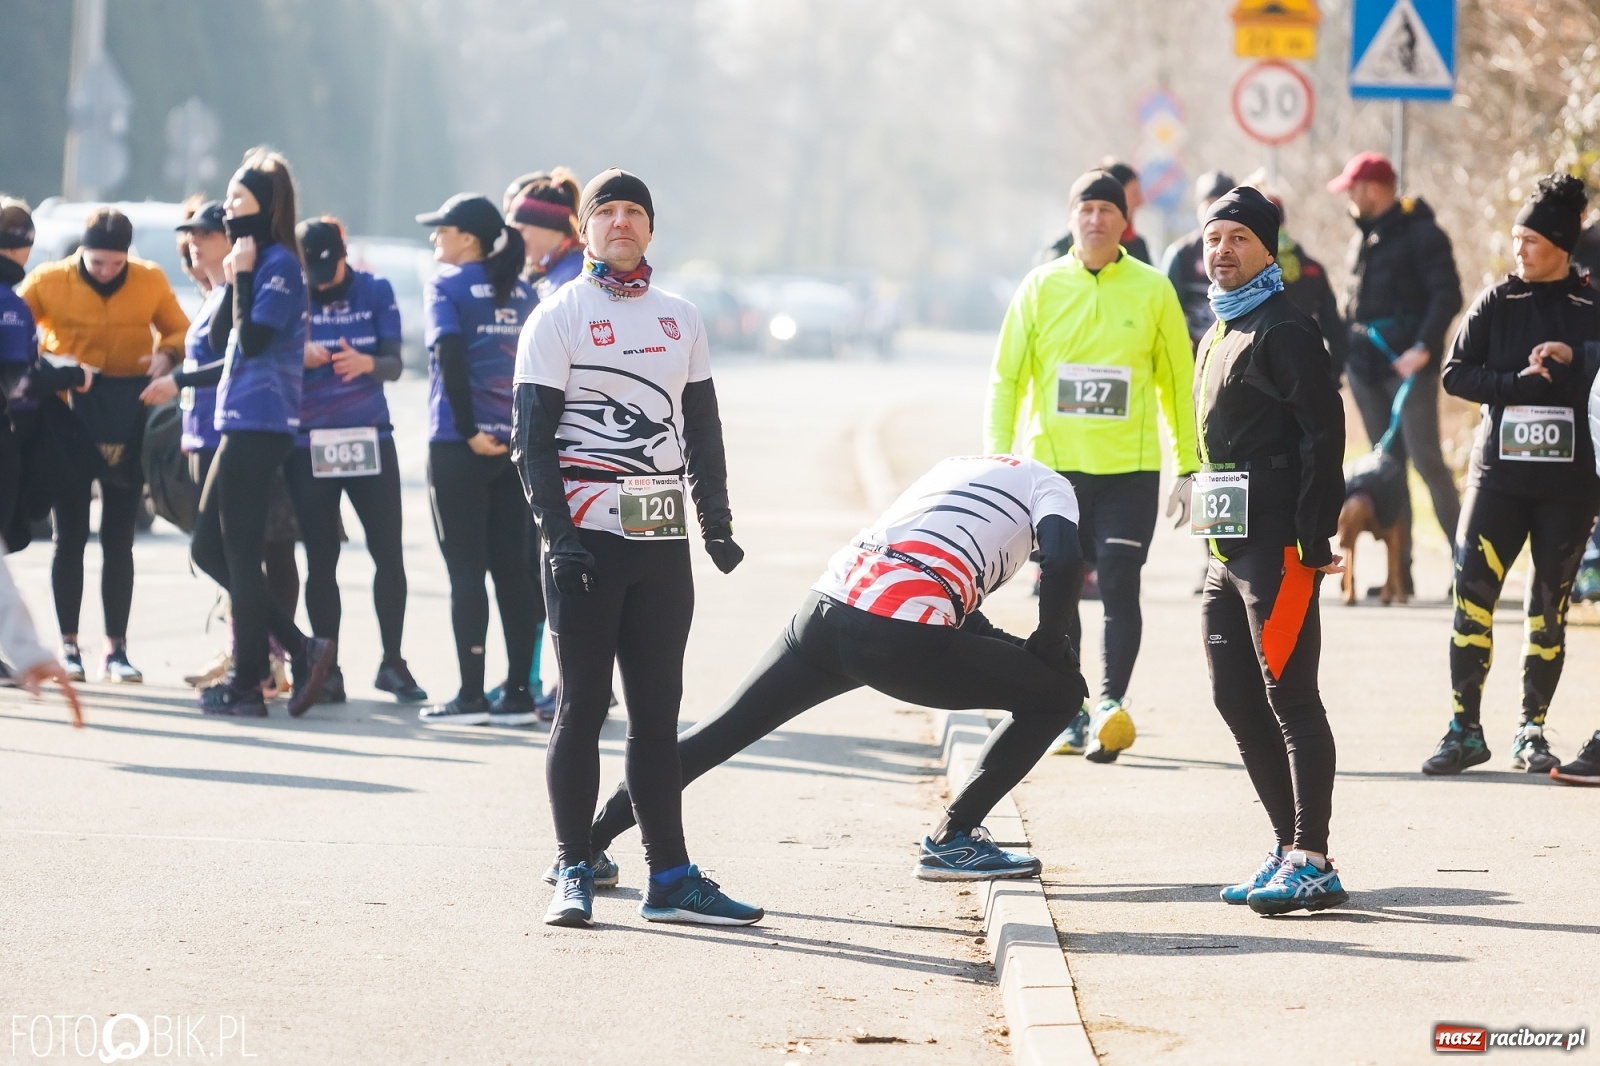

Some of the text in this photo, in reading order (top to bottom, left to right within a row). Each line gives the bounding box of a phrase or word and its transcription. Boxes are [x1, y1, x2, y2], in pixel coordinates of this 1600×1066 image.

[1247, 82, 1300, 119] 30
[1074, 381, 1112, 403] 127
[1514, 422, 1560, 445] 080
[324, 442, 365, 463] 063
[638, 496, 675, 521] 120
[1200, 493, 1232, 519] 132
